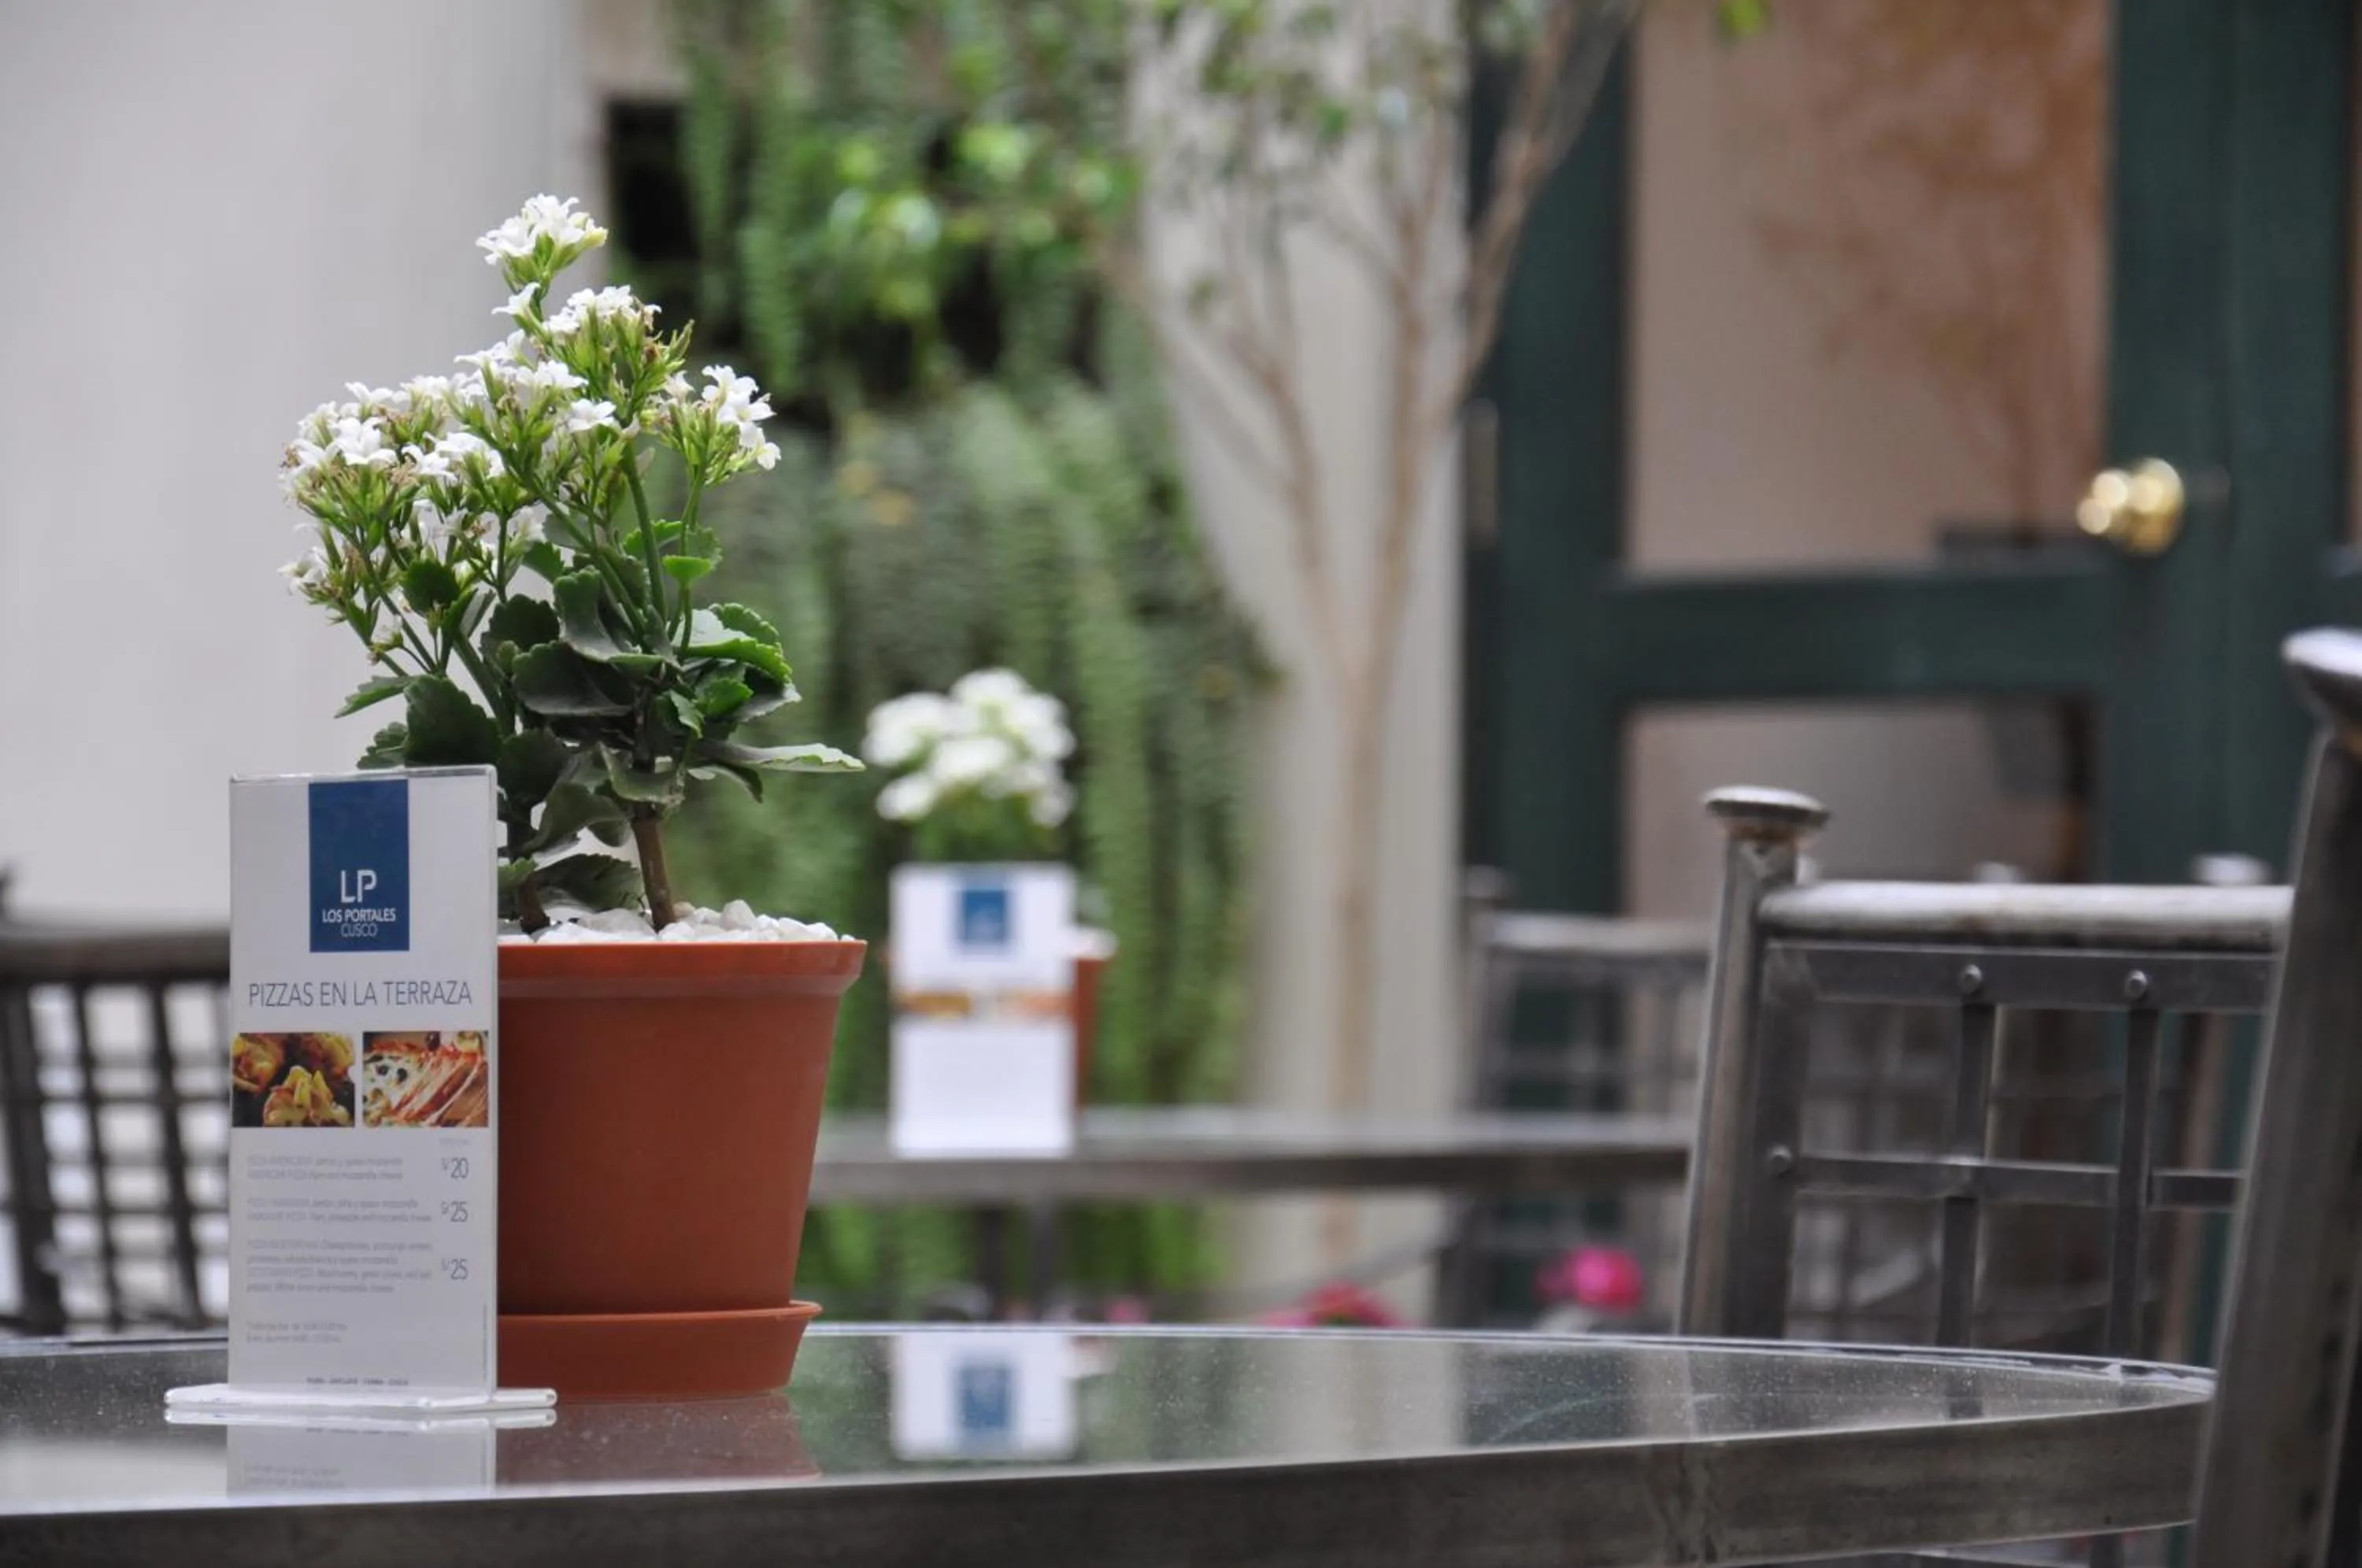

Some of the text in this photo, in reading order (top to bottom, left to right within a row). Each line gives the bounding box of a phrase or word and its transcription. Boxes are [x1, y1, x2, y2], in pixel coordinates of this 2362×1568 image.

[340, 869, 377, 903] LP
[322, 908, 396, 923] LOS PORTALES
[340, 923, 377, 937] CUSCO
[249, 980, 472, 1007] PIZZAS EN LA TERRAZA
